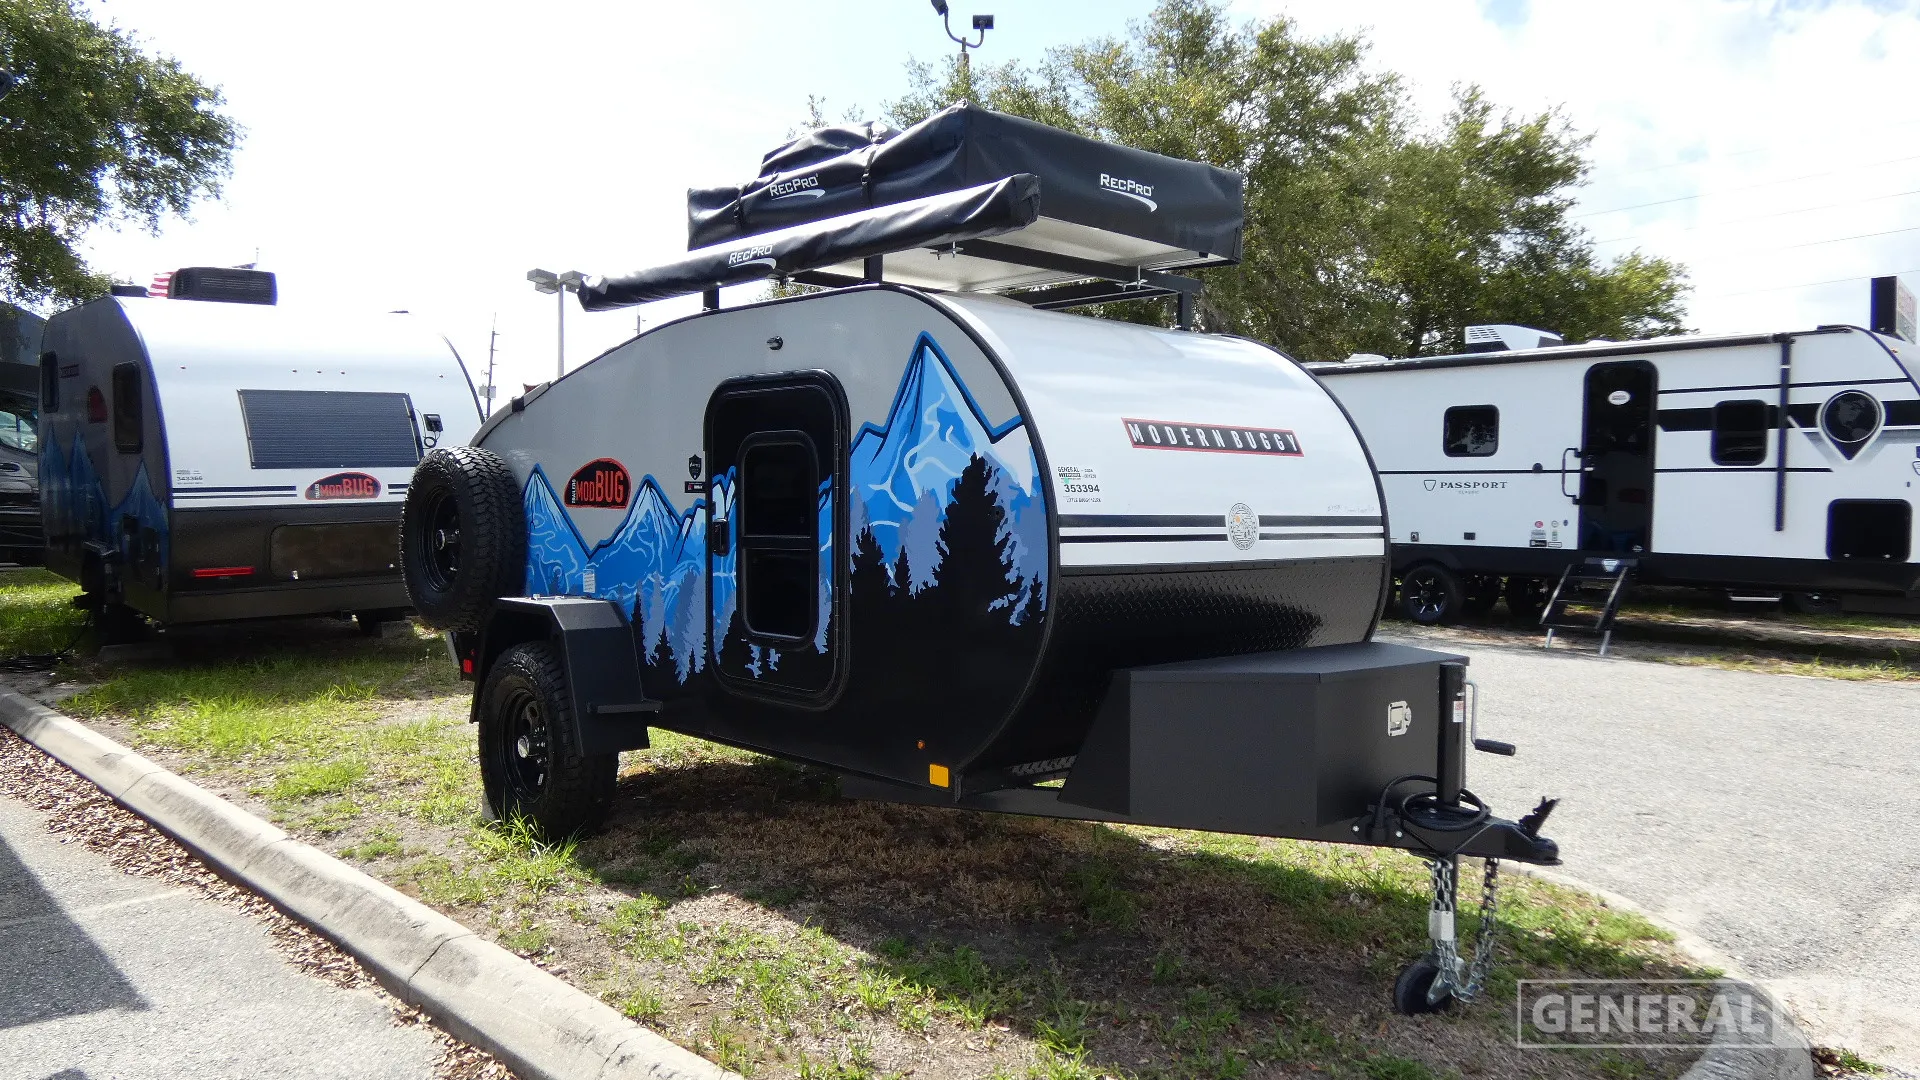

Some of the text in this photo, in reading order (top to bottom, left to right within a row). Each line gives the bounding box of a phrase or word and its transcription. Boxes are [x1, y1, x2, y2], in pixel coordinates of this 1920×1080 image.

[1127, 422, 1298, 452] MODERN BUGGY
[1063, 484, 1100, 493] 353394
[1440, 481, 1508, 489] PASSPORT
